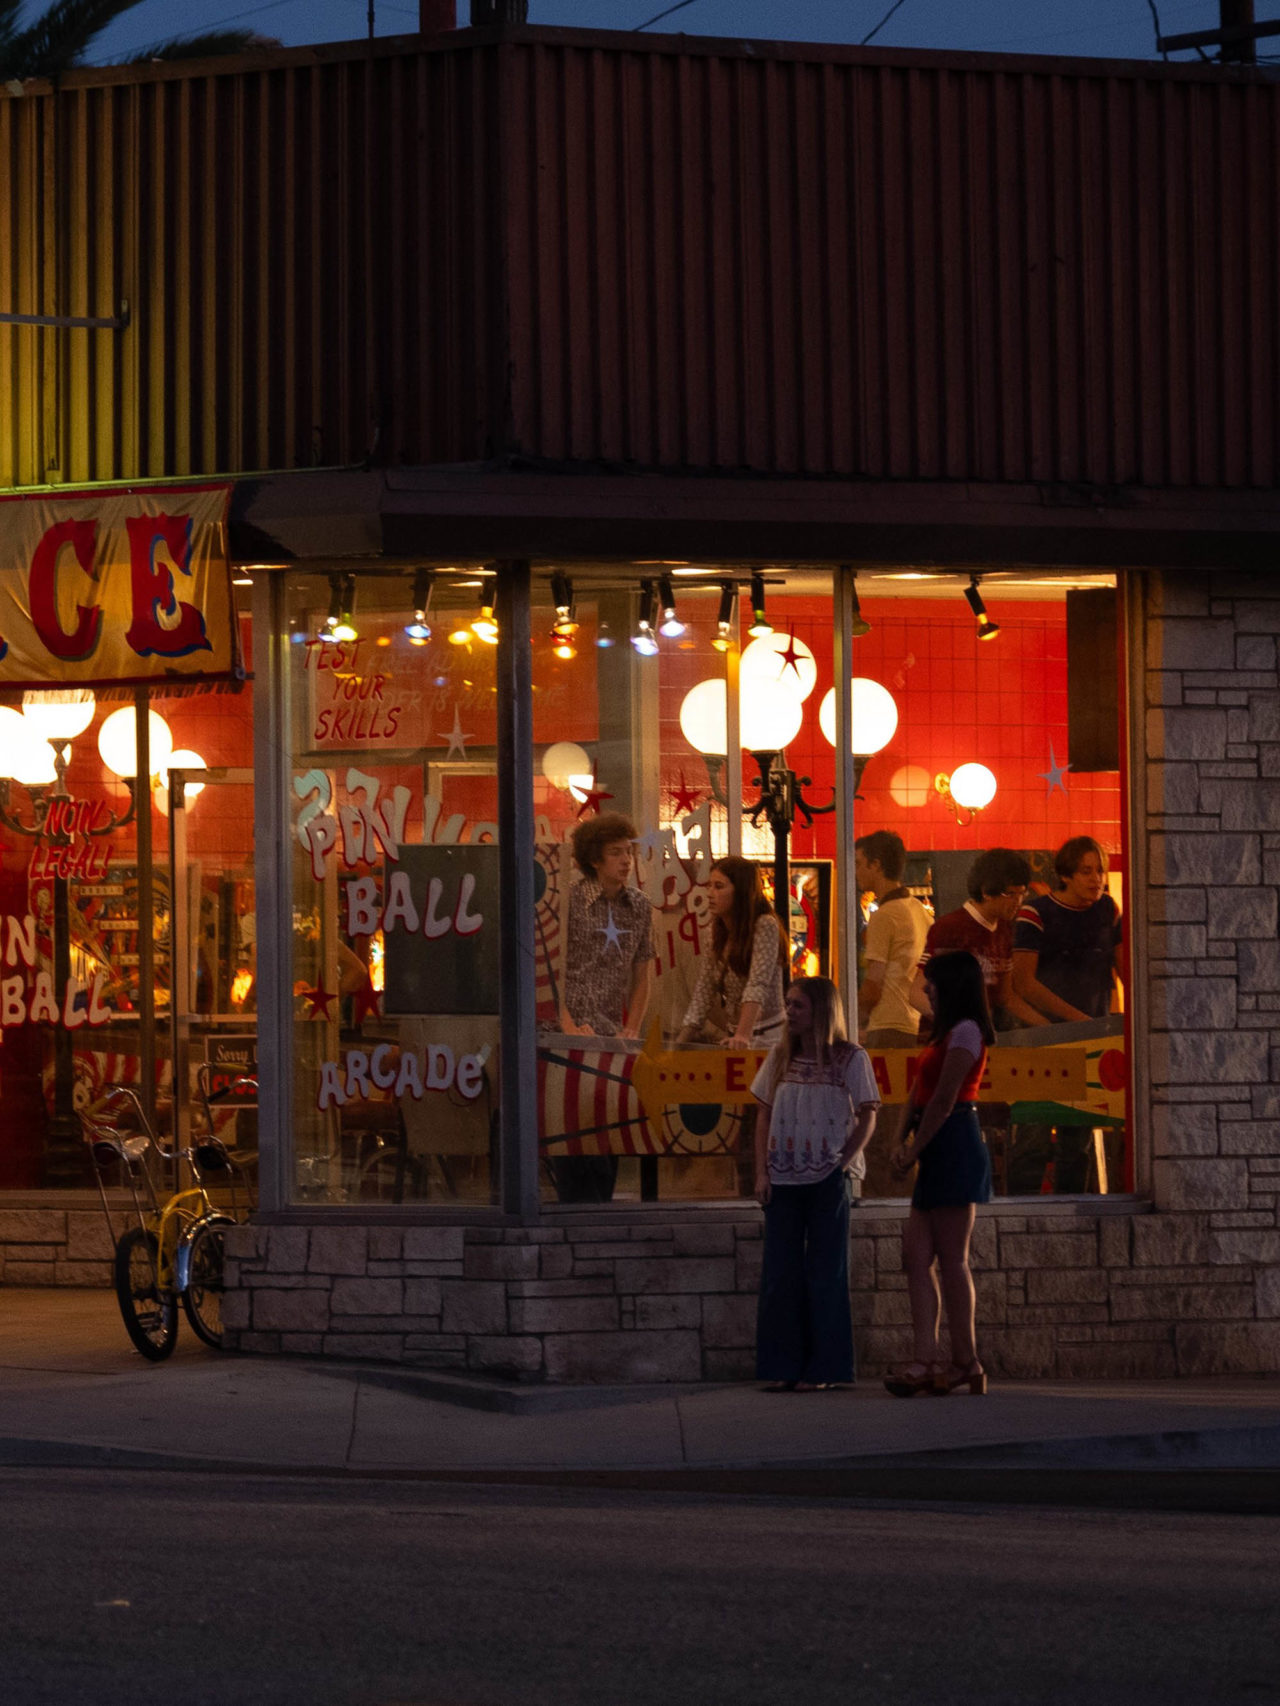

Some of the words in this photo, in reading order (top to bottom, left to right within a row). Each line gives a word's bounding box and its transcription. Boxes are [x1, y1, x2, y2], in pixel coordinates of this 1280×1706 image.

[302, 637, 367, 672] TEST
[331, 674, 385, 701] YOUR
[313, 706, 402, 741] SKILLS
[28, 845, 114, 881] LEGAL!
[346, 871, 484, 939] BALL
[1, 972, 112, 1030] BALL
